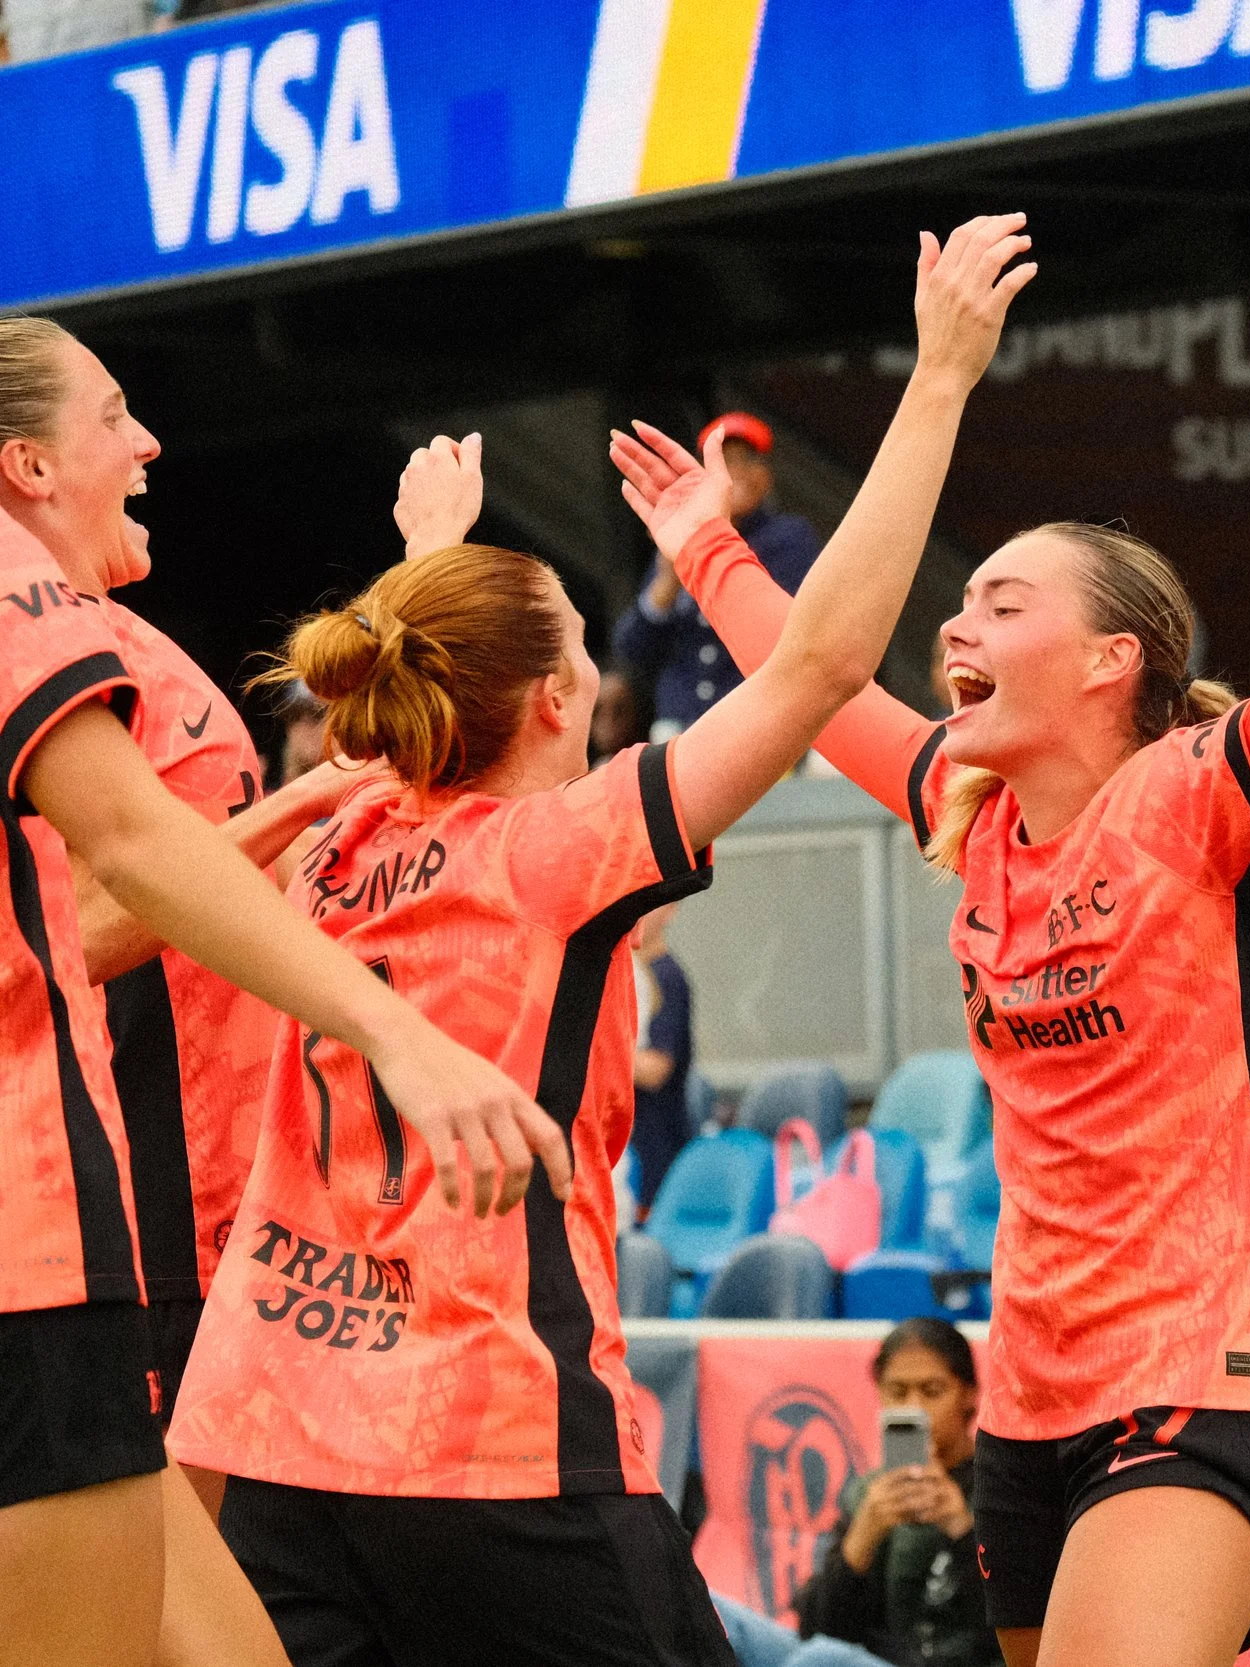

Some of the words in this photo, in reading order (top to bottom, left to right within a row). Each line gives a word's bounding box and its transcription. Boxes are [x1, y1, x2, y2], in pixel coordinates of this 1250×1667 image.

[112, 19, 401, 254] VISA
[1001, 962, 1107, 1007] Sutter
[1004, 999, 1126, 1050] Health
[250, 1220, 416, 1304] TRADER
[253, 1285, 408, 1353] JOE'S
